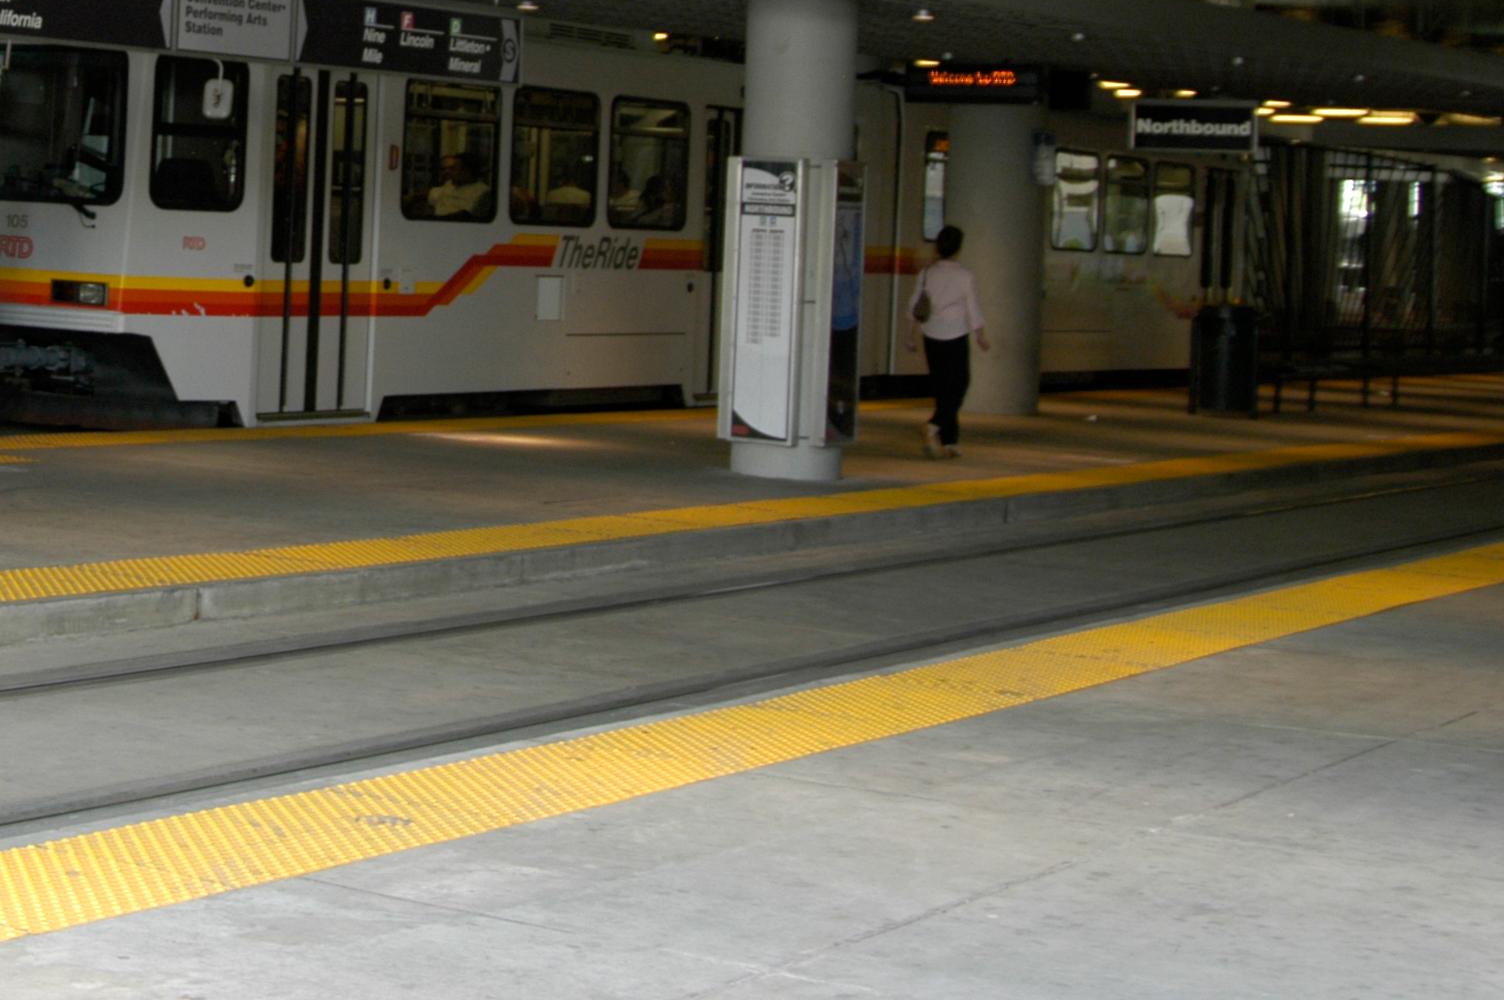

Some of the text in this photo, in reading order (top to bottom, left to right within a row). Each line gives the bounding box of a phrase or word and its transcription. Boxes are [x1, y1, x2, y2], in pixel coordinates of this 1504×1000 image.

[185, 5, 268, 27] Performing Arts
[184, 21, 224, 36] Station
[363, 27, 386, 44] Nine
[399, 32, 435, 49] Lincoln
[448, 37, 486, 55] Littleton
[362, 47, 384, 64] Mile
[448, 56, 482, 73] Mineral
[928, 70, 974, 86] Welcome
[1135, 117, 1252, 137] Northbound
[5, 213, 30, 229] 105
[182, 235, 207, 251] RTD
[559, 234, 639, 271] TheRide
